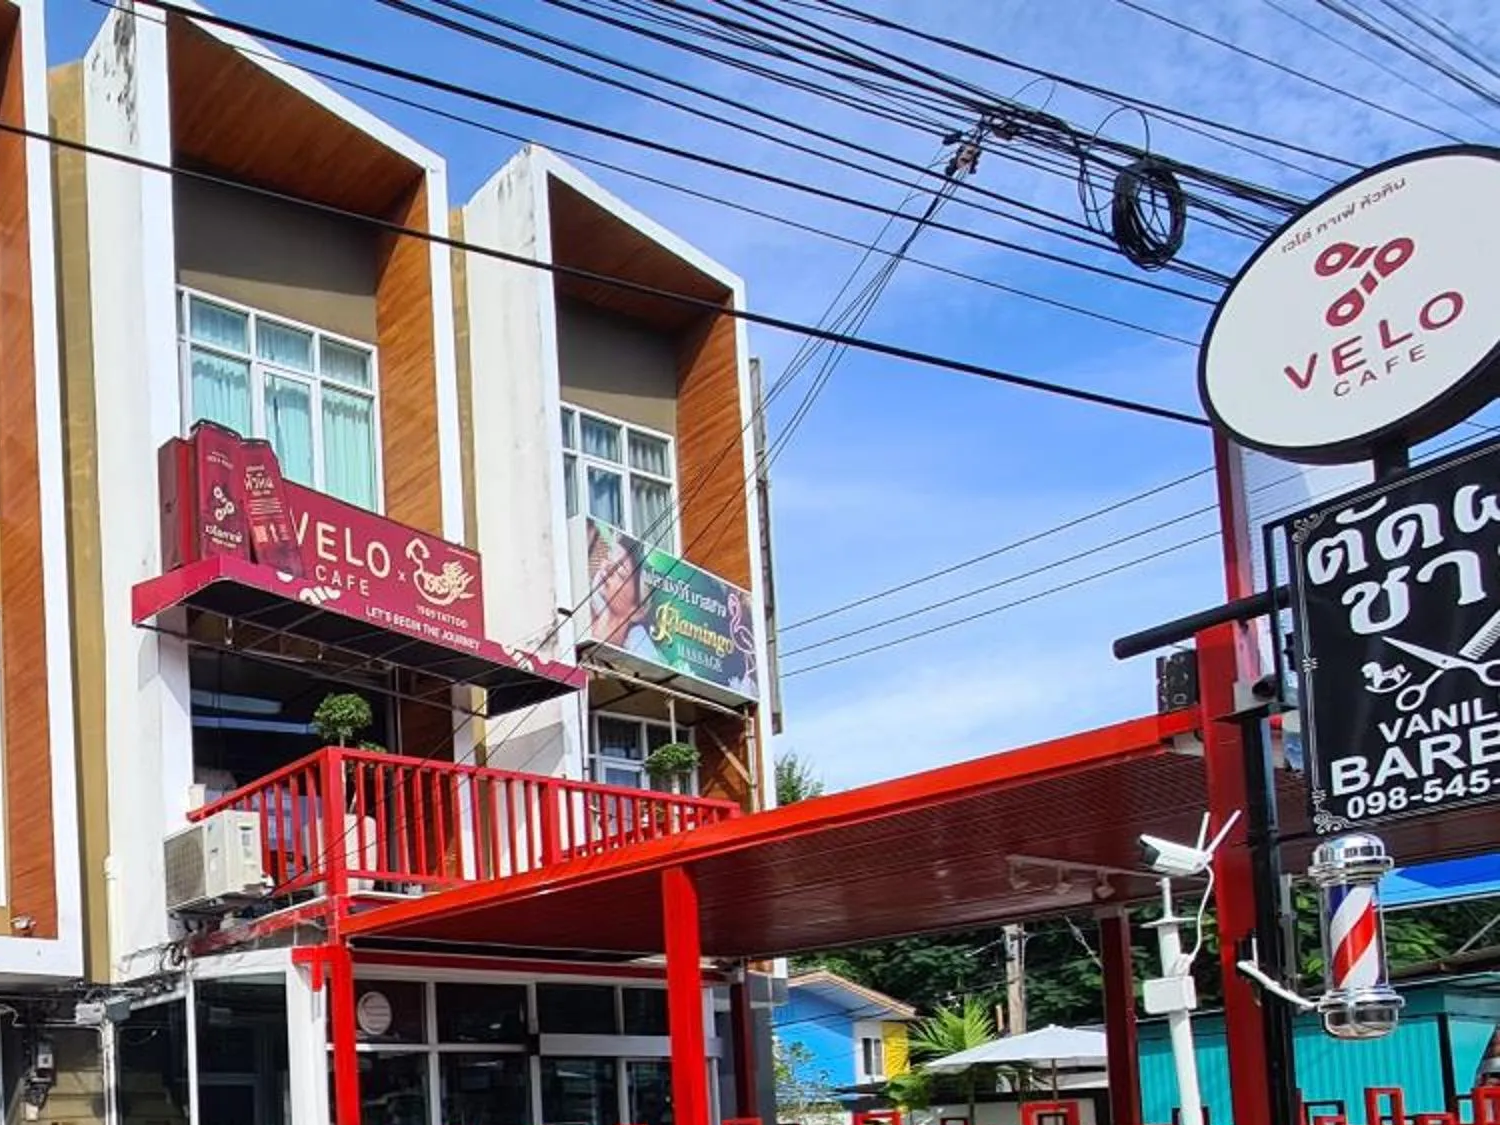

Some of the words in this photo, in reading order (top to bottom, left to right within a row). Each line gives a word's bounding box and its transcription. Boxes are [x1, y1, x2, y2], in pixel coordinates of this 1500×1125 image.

[1284, 291, 1464, 390] VELO
[1333, 344, 1427, 397] CAFE
[289, 507, 391, 579] VELO
[316, 564, 370, 597] CAFE
[393, 614, 421, 632] BEGIN
[423, 622, 440, 639] THE
[442, 630, 480, 651] JOURNEY
[1378, 697, 1499, 743] VANIL
